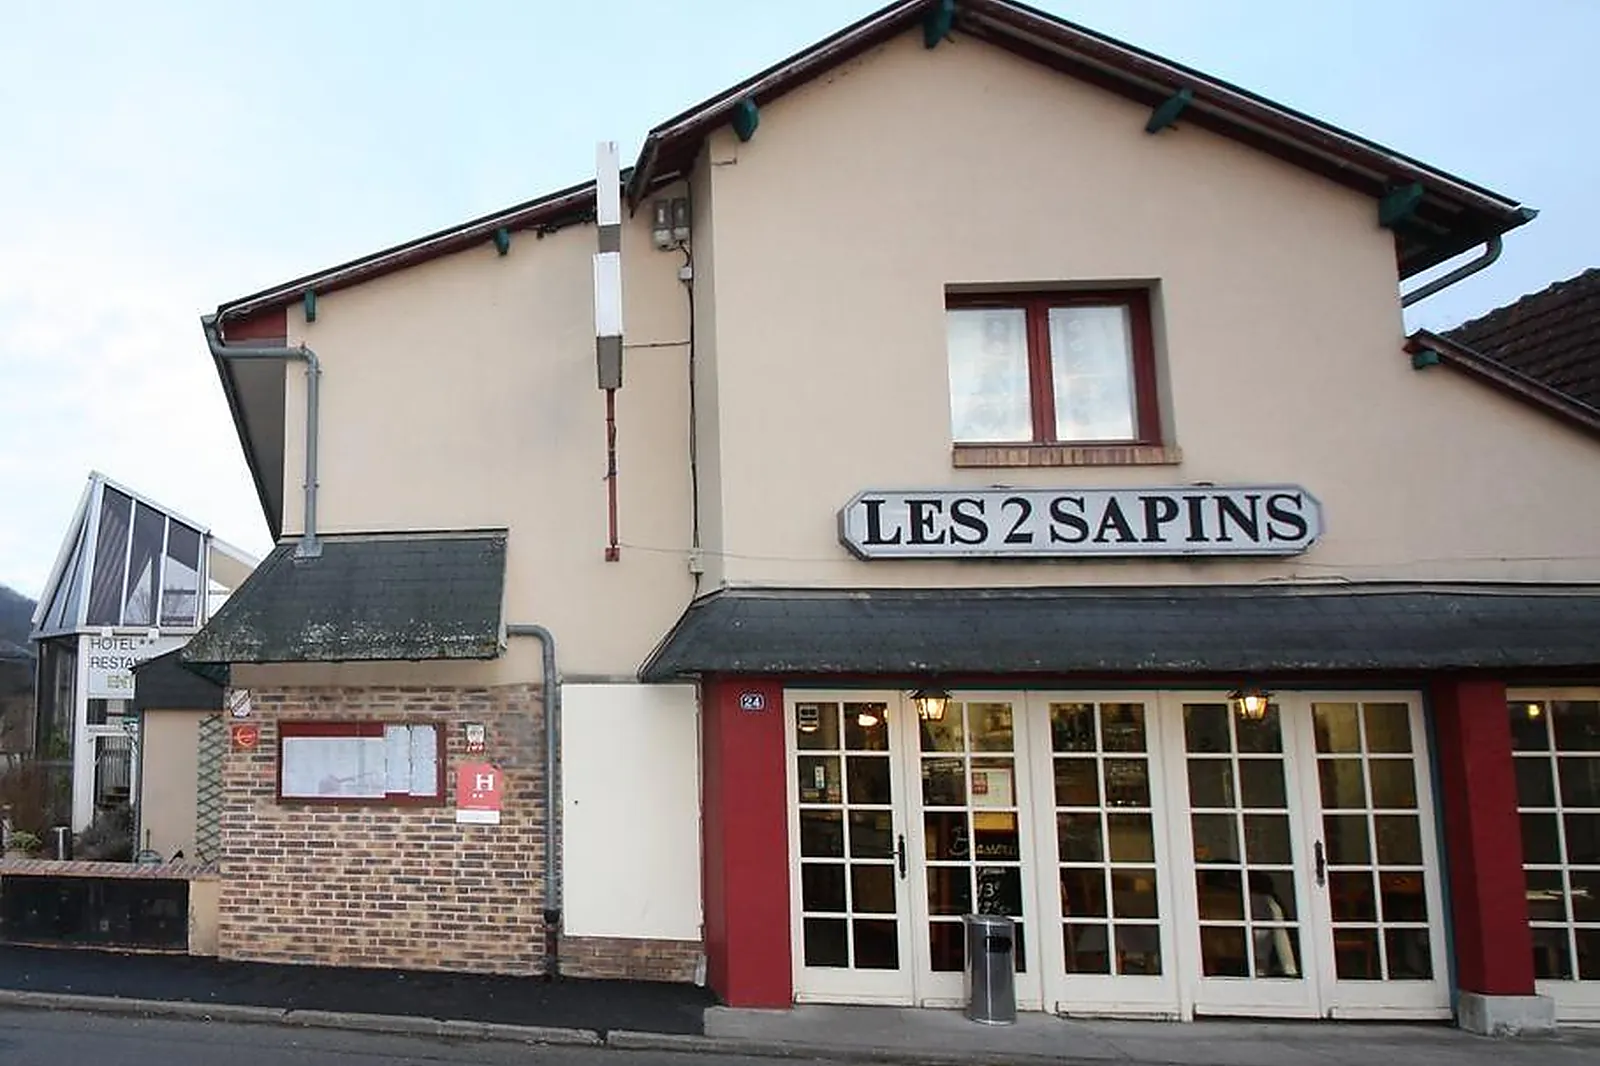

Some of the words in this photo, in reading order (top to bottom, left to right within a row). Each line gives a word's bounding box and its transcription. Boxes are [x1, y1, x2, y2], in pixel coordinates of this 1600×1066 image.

[861, 497, 989, 545] LES
[1004, 496, 1034, 544] 2
[1049, 492, 1309, 543] SAPINS
[743, 693, 760, 703] 24
[475, 773, 494, 791] H
